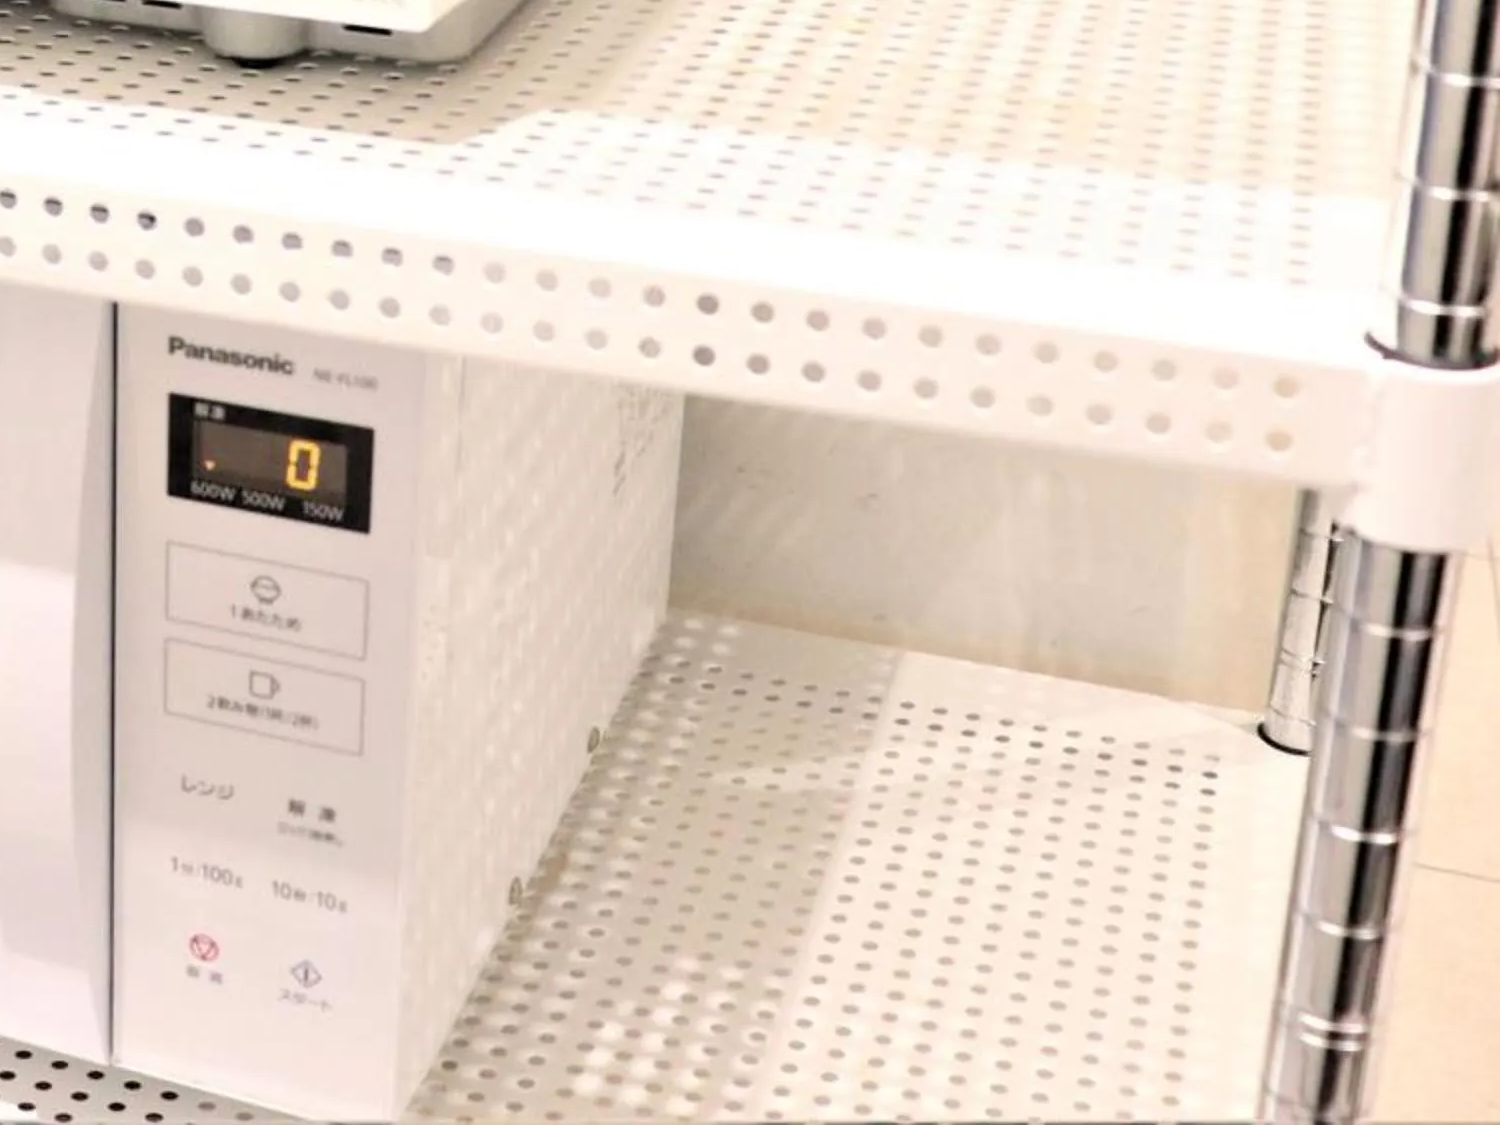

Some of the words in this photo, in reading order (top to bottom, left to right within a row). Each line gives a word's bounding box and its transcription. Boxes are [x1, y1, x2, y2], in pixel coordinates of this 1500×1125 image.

[168, 336, 295, 375] Panasonic
[286, 438, 321, 492] 0
[190, 479, 237, 501] 600W
[241, 488, 286, 512] 500W
[303, 500, 344, 523] 150W
[180, 774, 235, 800] レンジ
